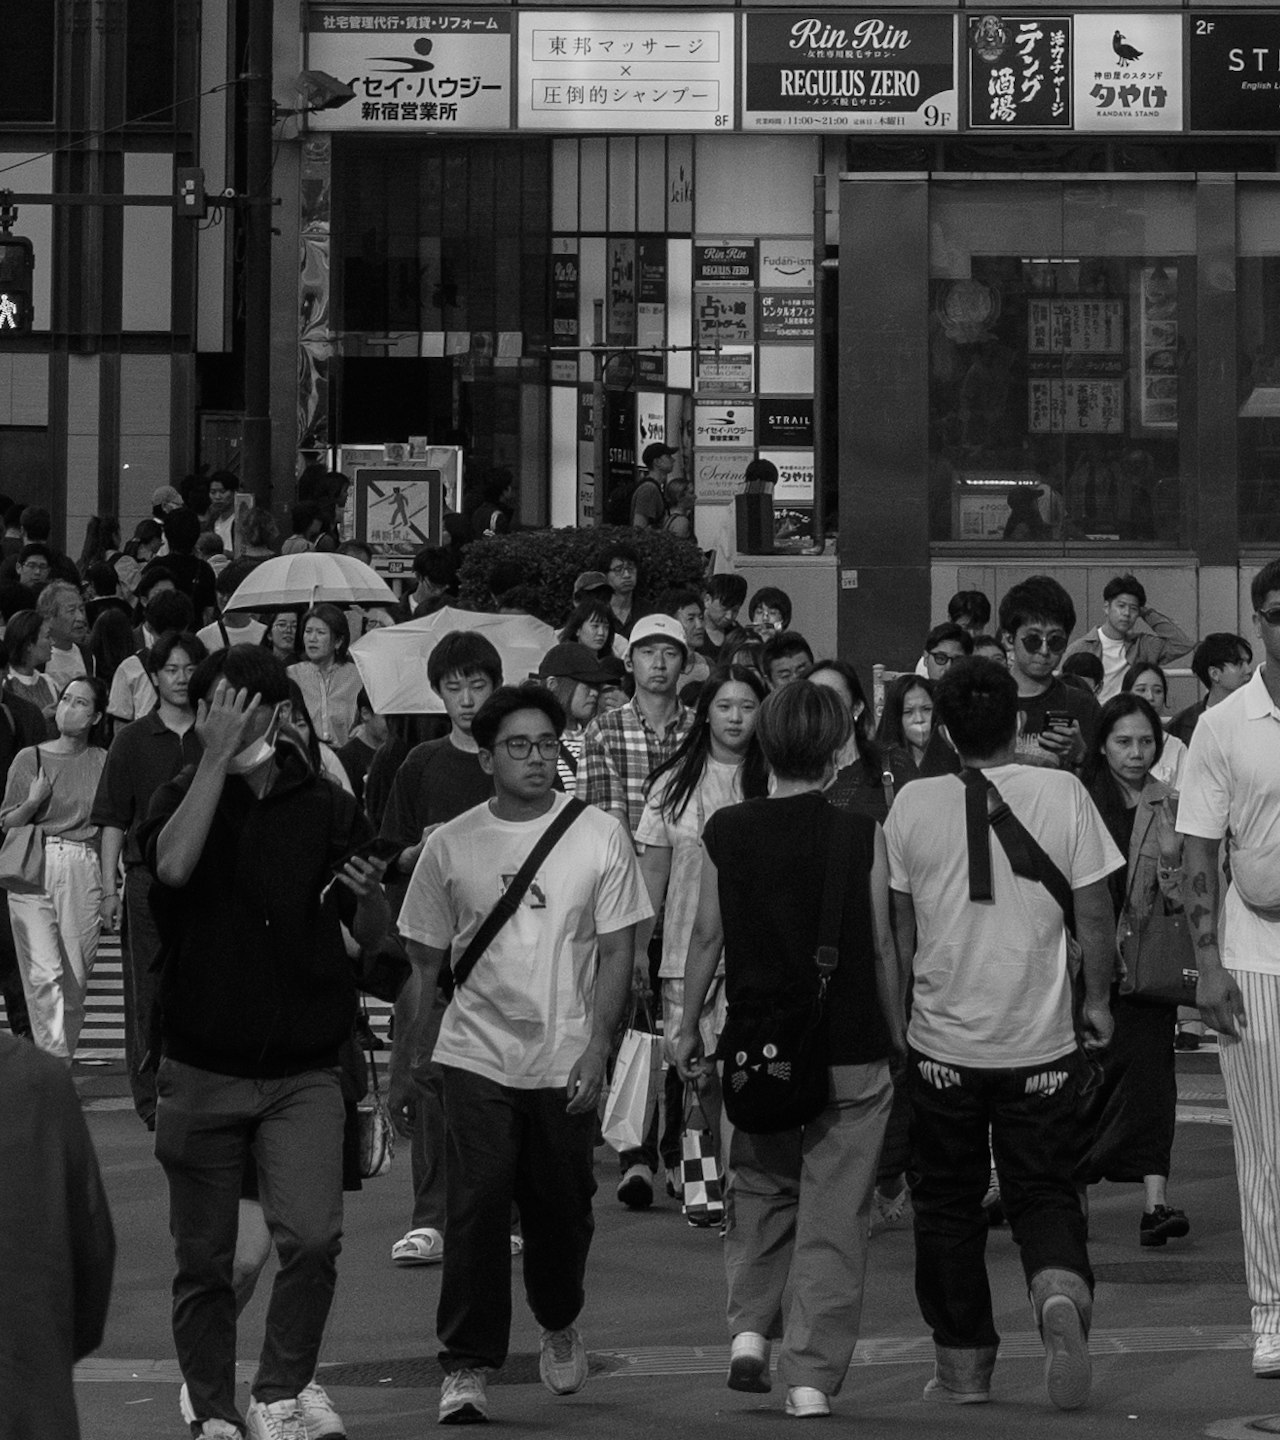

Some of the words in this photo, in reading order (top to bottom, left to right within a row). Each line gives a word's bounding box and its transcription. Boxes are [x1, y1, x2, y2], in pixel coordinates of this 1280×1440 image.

[323, 15, 498, 30] 社宅管理代行・賃貸・リフォーム
[1195, 19, 1216, 35] 2F
[789, 18, 849, 50] Rin
[851, 18, 912, 50] Rin
[548, 35, 705, 56] 東邦マッサージ
[1049, 29, 1066, 118] 活力チャージ
[1093, 71, 1163, 80] 神田屋のスタンド
[780, 69, 866, 97] REGULUS
[869, 69, 921, 97] ZERO
[1240, 81, 1272, 92] English
[543, 84, 709, 105] 圧倒的シャンプー
[361, 101, 458, 121] 新宿営業所
[923, 104, 952, 128] 9F
[1096, 110, 1133, 118] KANDAYA
[1134, 110, 1160, 118] STAND
[714, 115, 730, 127] 8F
[768, 415, 811, 425] STRAIL
